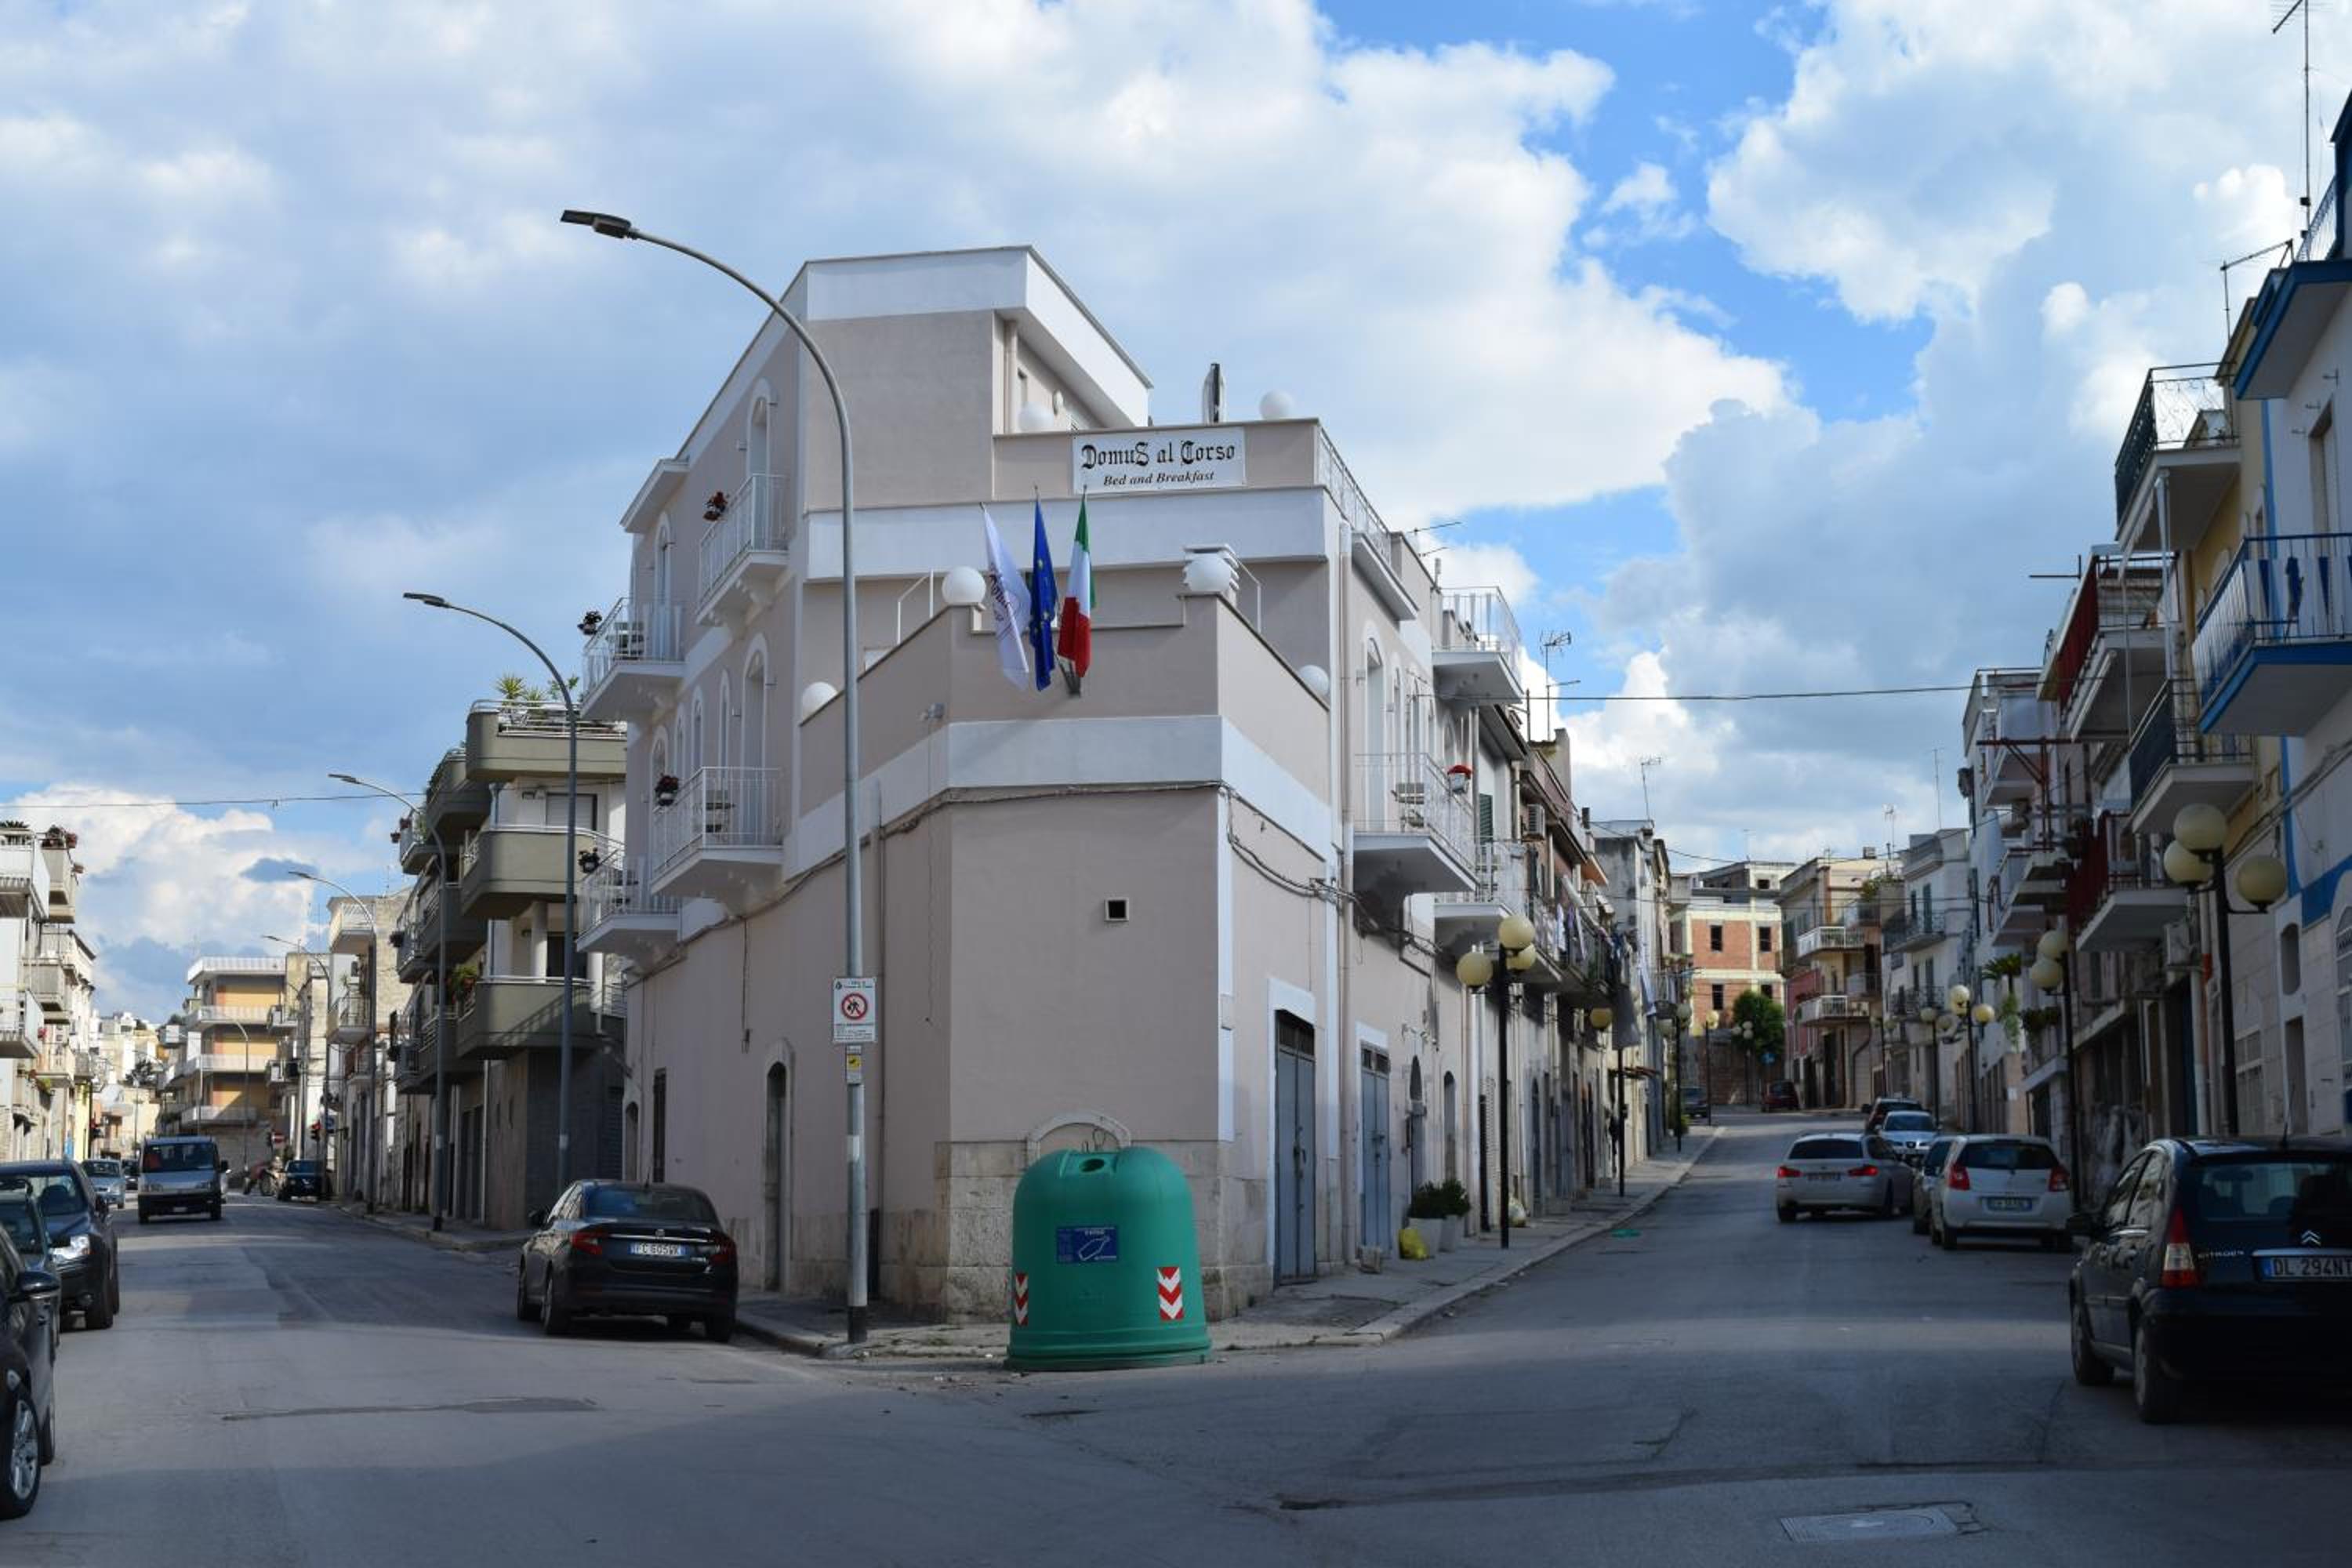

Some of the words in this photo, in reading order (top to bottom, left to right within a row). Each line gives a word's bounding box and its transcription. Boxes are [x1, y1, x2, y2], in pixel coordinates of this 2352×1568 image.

[1156, 442, 1174, 464] al
[1181, 440, 1236, 465] Corso
[1103, 475, 1127, 487] Bed
[1130, 474, 1152, 485] and
[1156, 471, 1214, 484] Breakfast
[2275, 1258, 2294, 1276] DL
